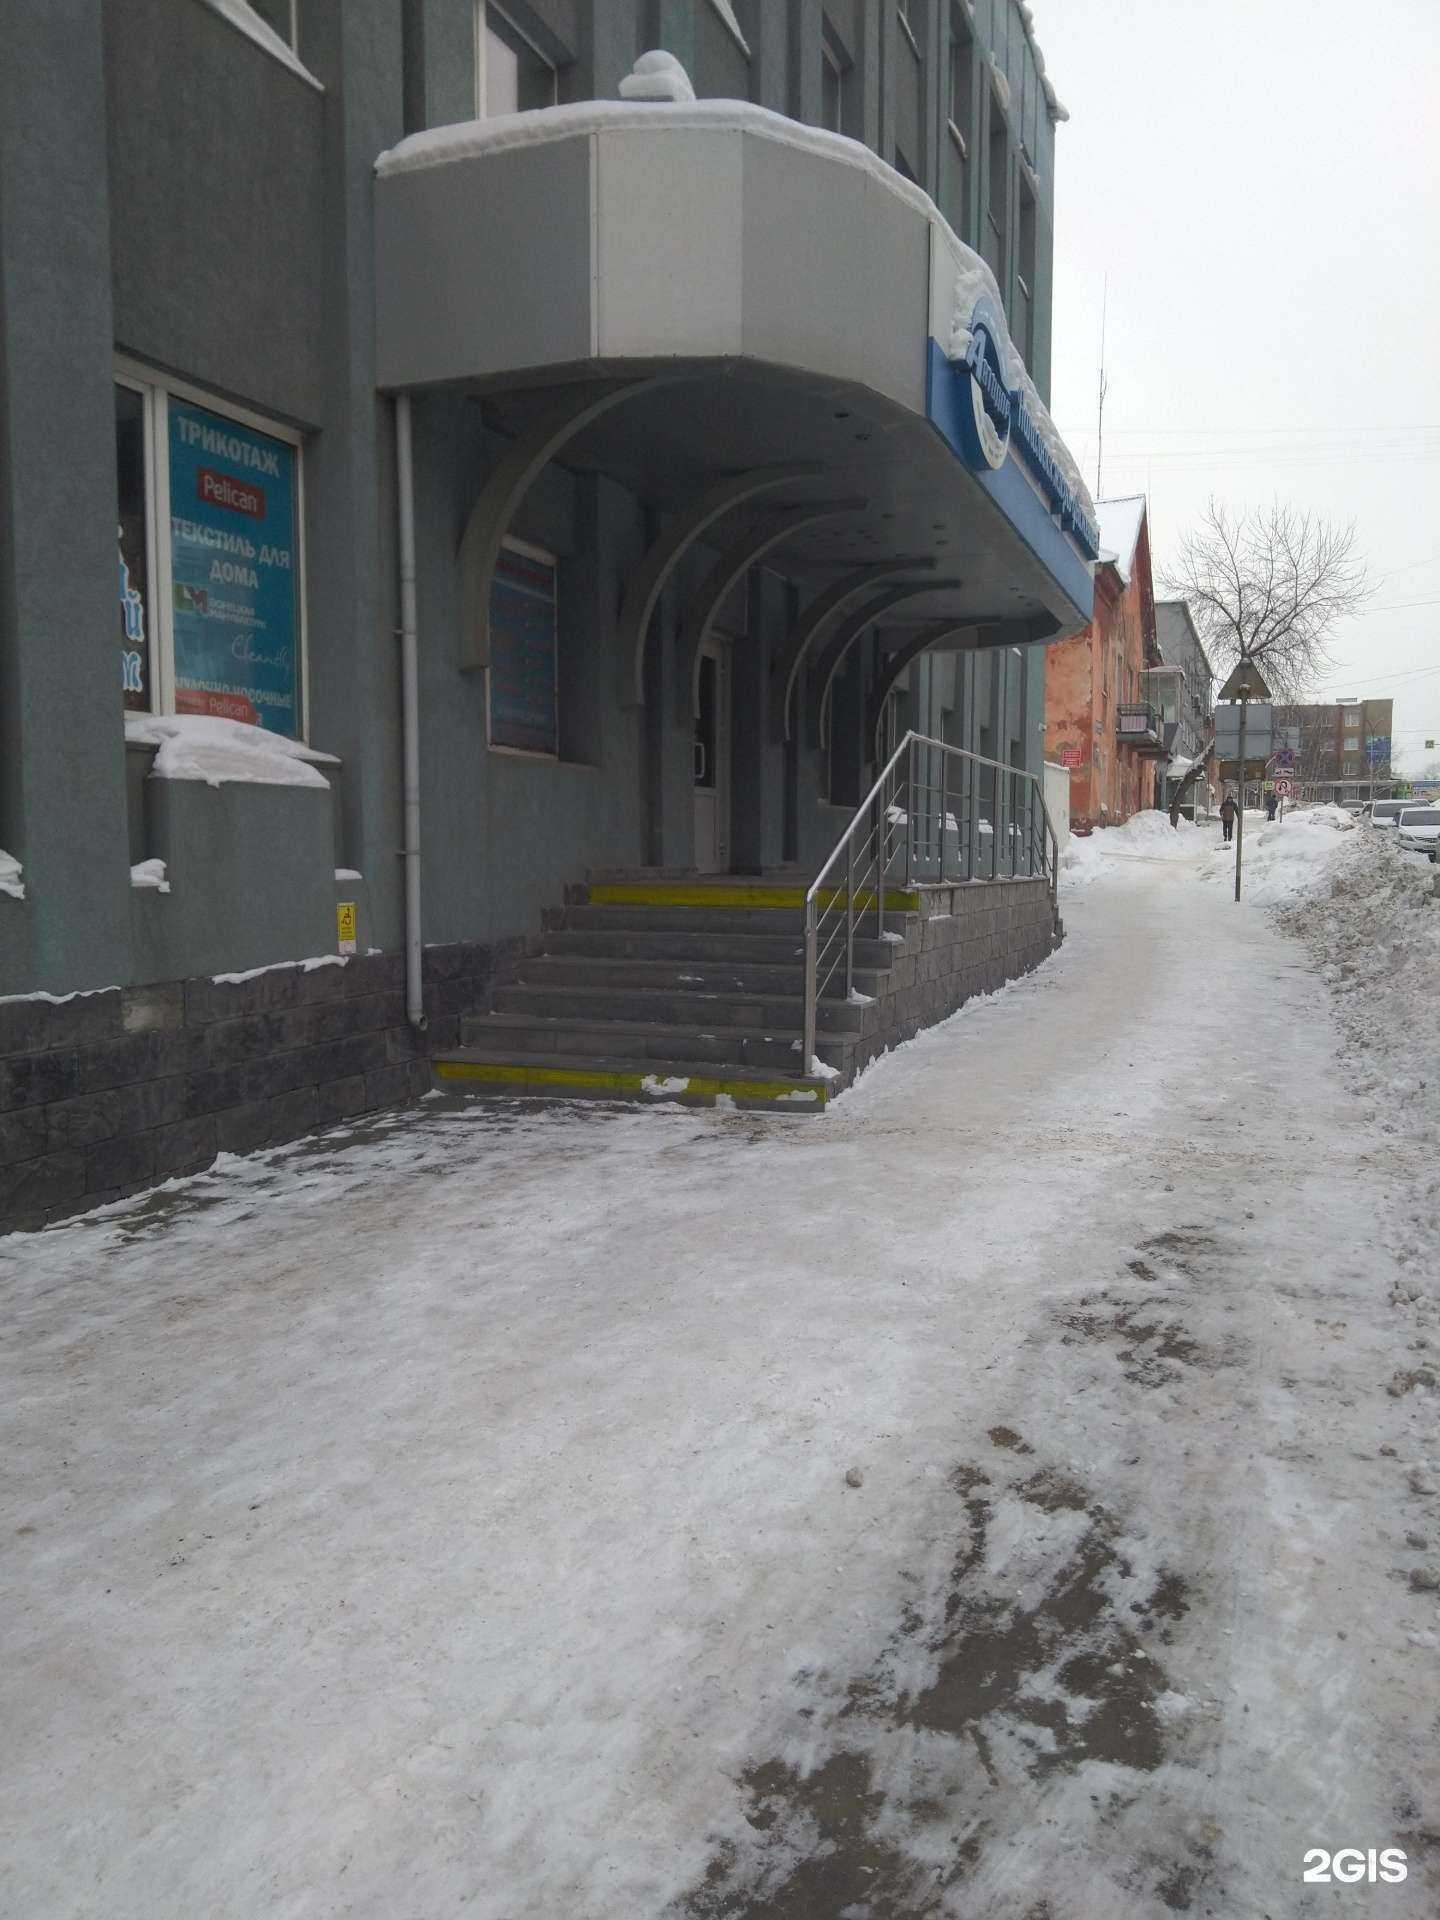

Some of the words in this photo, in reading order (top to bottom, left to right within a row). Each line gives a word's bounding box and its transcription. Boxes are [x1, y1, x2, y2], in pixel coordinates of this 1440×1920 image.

[177, 415, 280, 478] ТРИКОТАЖ
[204, 474, 257, 513] Pelican
[171, 516, 255, 558] ТЕКСТИЛЬ
[259, 545, 290, 569] ДЛЯ
[209, 559, 259, 589] ДОМА
[208, 696, 248, 718] Pelican
